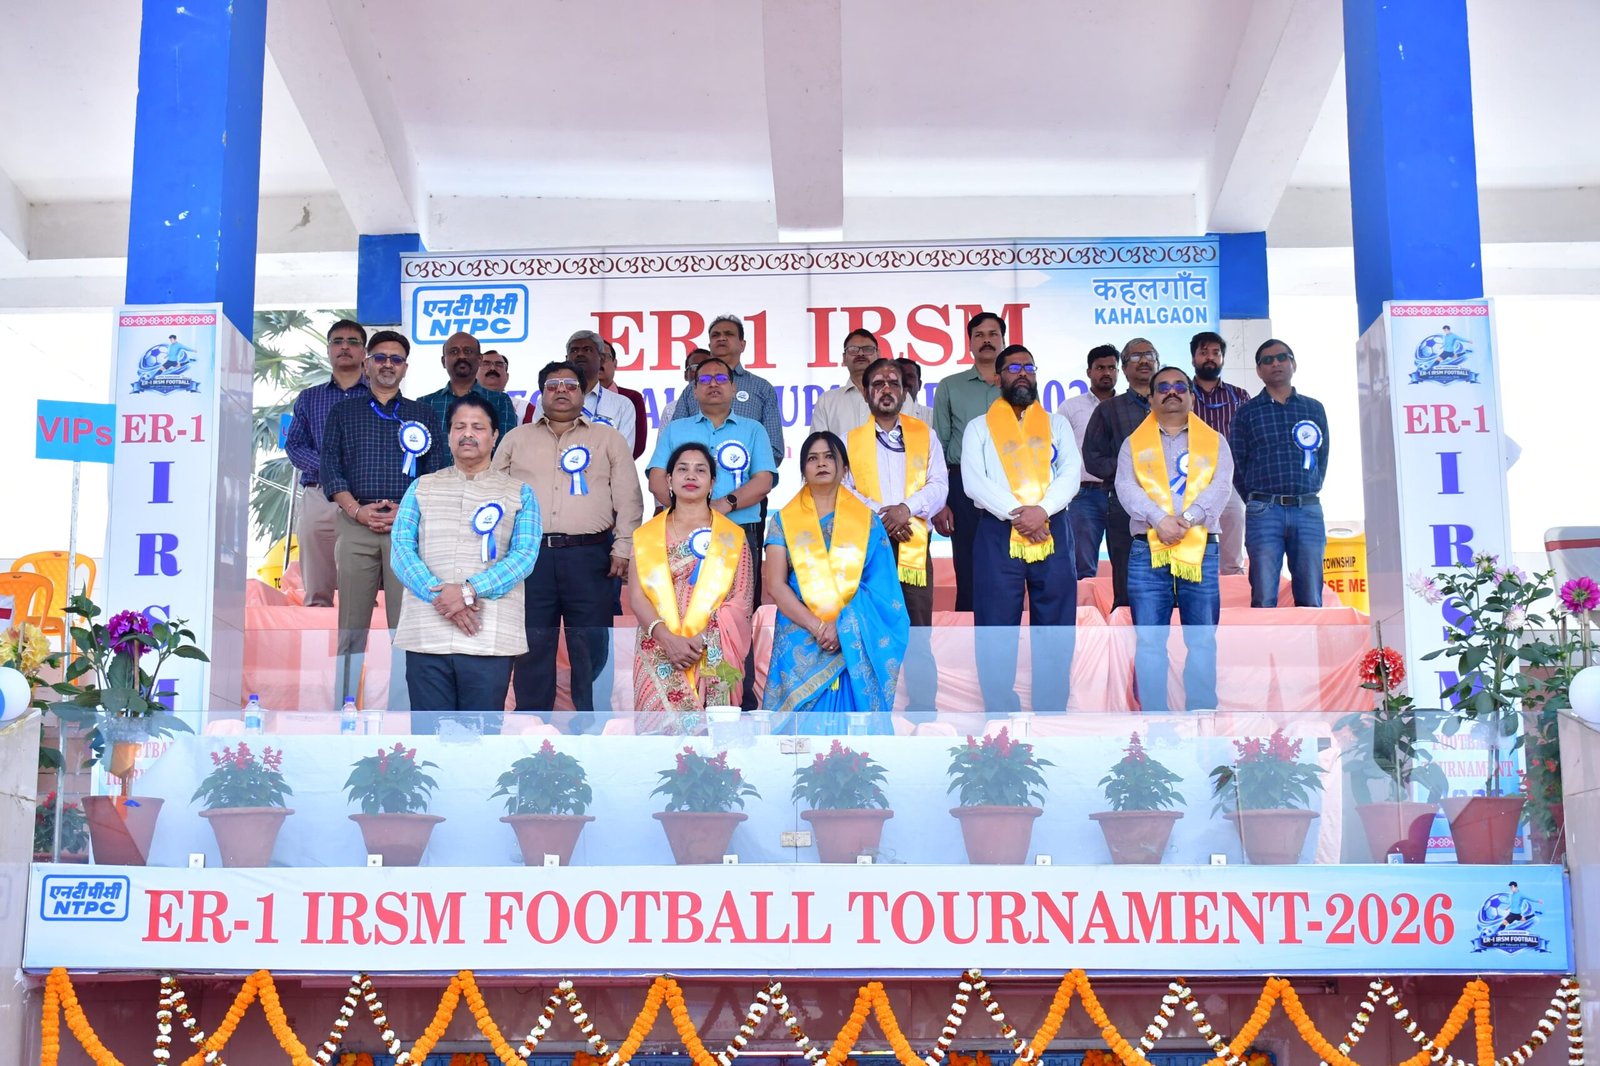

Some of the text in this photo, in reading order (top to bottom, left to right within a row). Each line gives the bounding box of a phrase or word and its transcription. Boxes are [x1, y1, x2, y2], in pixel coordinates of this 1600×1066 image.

[1093, 271, 1208, 306] कहलगाँव
[422, 292, 519, 318] एनटीपीसी
[1094, 307, 1208, 324] KAHALGAON
[429, 318, 512, 337] NTPC
[588, 310, 777, 371] ER1
[38, 415, 113, 447] VIPs
[121, 414, 206, 444] ER-1
[1403, 404, 1490, 434] ER-1
[1323, 556, 1357, 569] TOWNSHIP
[1348, 578, 1367, 593] ME
[49, 881, 123, 900] एनटीपीसी
[53, 901, 117, 915] NTPC
[142, 889, 1455, 945] ER-1 IRSM FOOTBALL TOURNAMENT-2026
